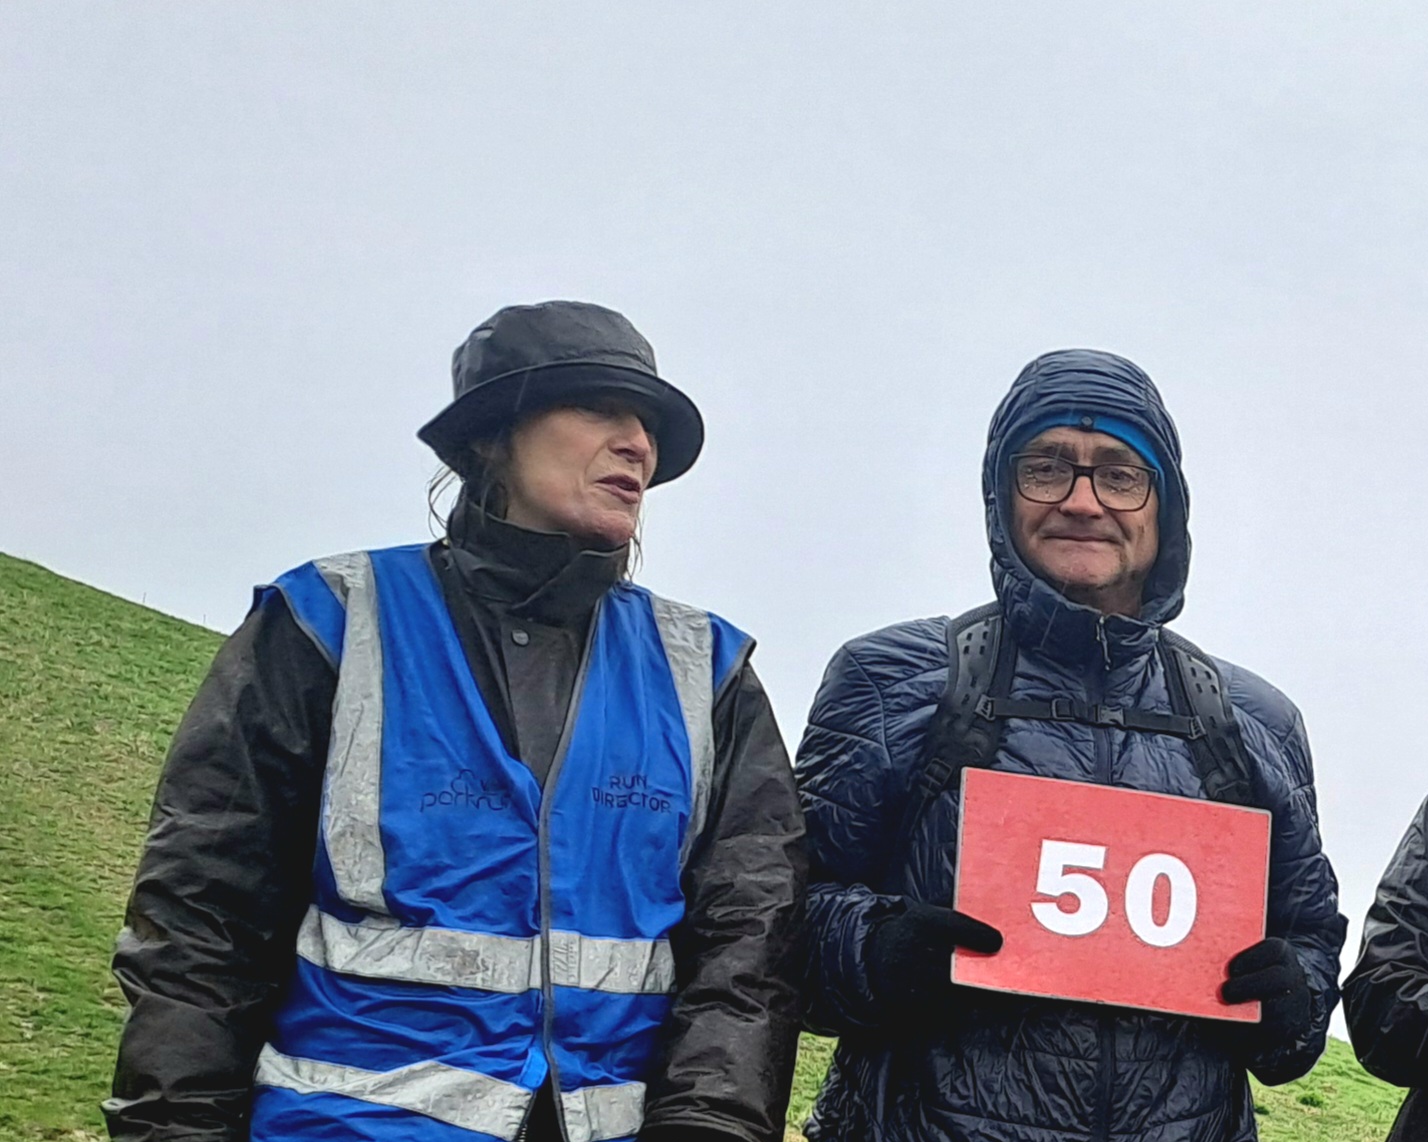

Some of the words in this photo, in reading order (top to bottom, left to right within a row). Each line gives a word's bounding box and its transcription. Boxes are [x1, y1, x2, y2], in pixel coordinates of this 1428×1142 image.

[609, 775, 647, 790] RUN
[592, 787, 671, 813] DIRECTOR
[1030, 839, 1198, 947] 50
